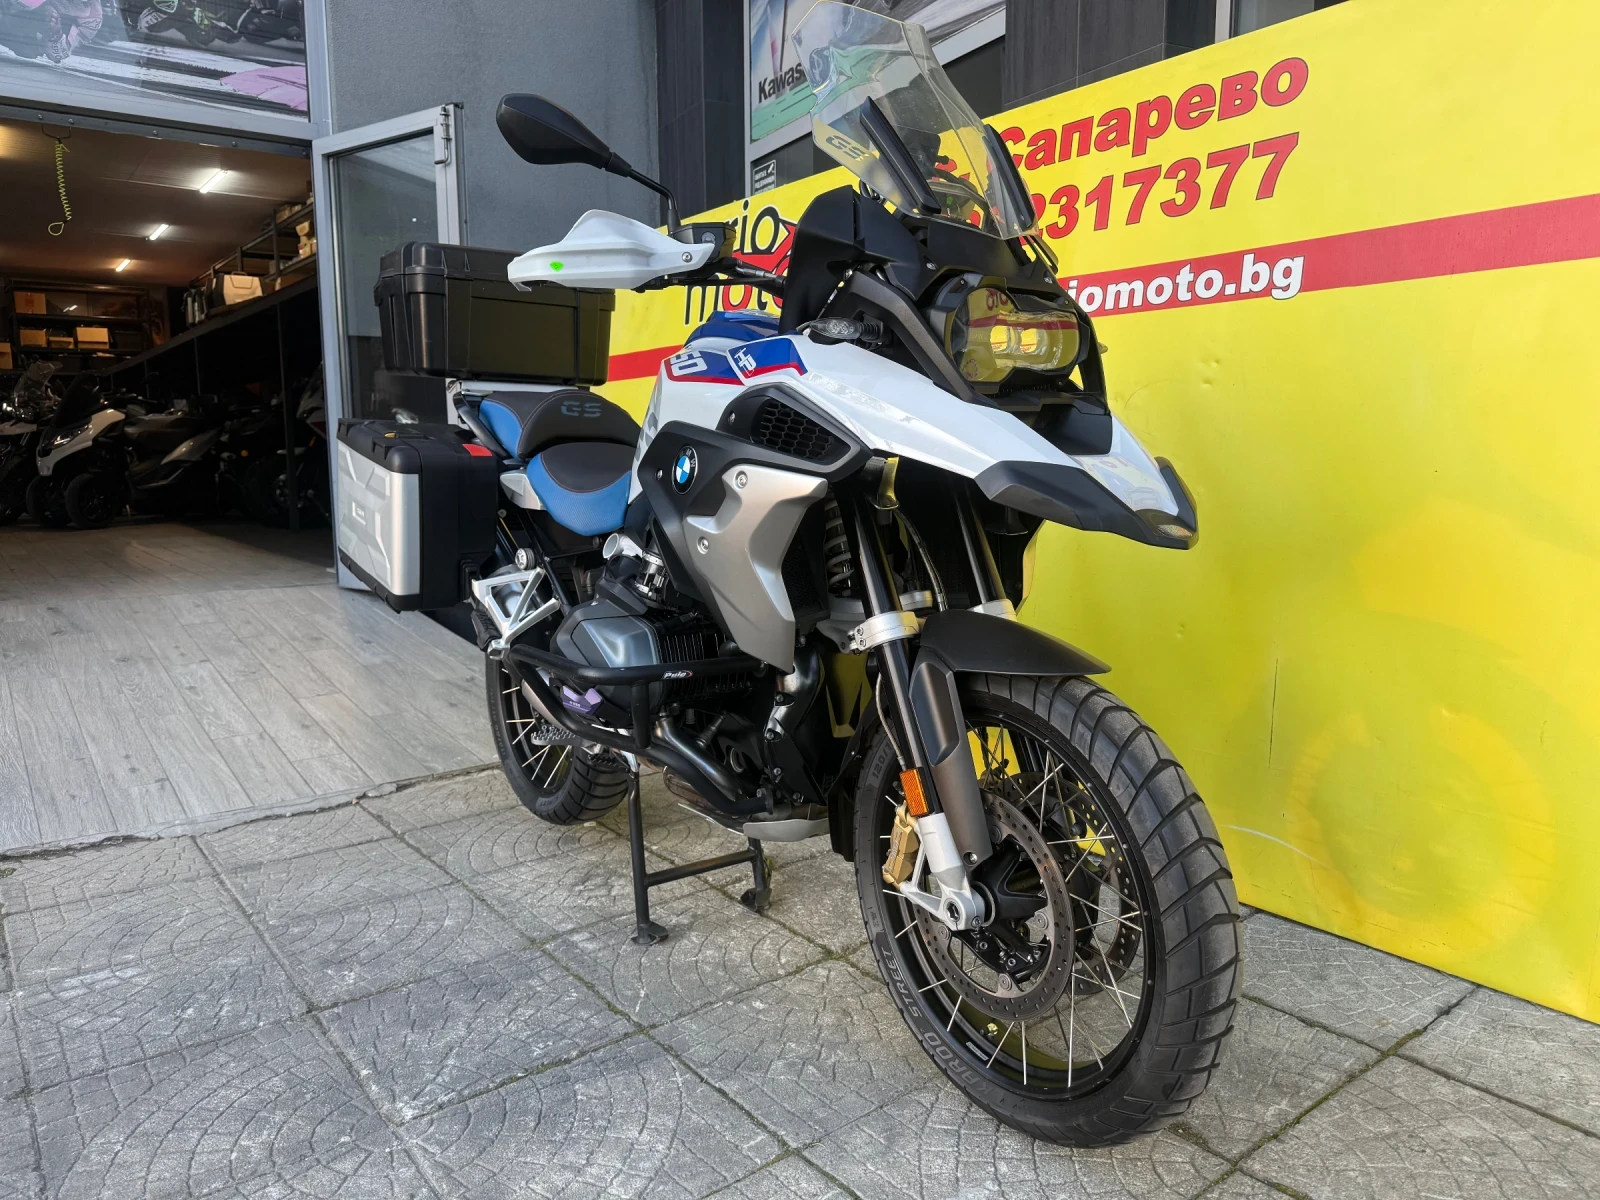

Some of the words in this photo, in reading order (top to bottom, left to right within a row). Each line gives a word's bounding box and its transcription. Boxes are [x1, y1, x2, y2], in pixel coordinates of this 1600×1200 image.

[759, 62, 809, 103] Kawas
[1066, 253, 1306, 313] iomoto.bg
[561, 401, 603, 417] GS
[881, 946, 923, 1018] STREET
